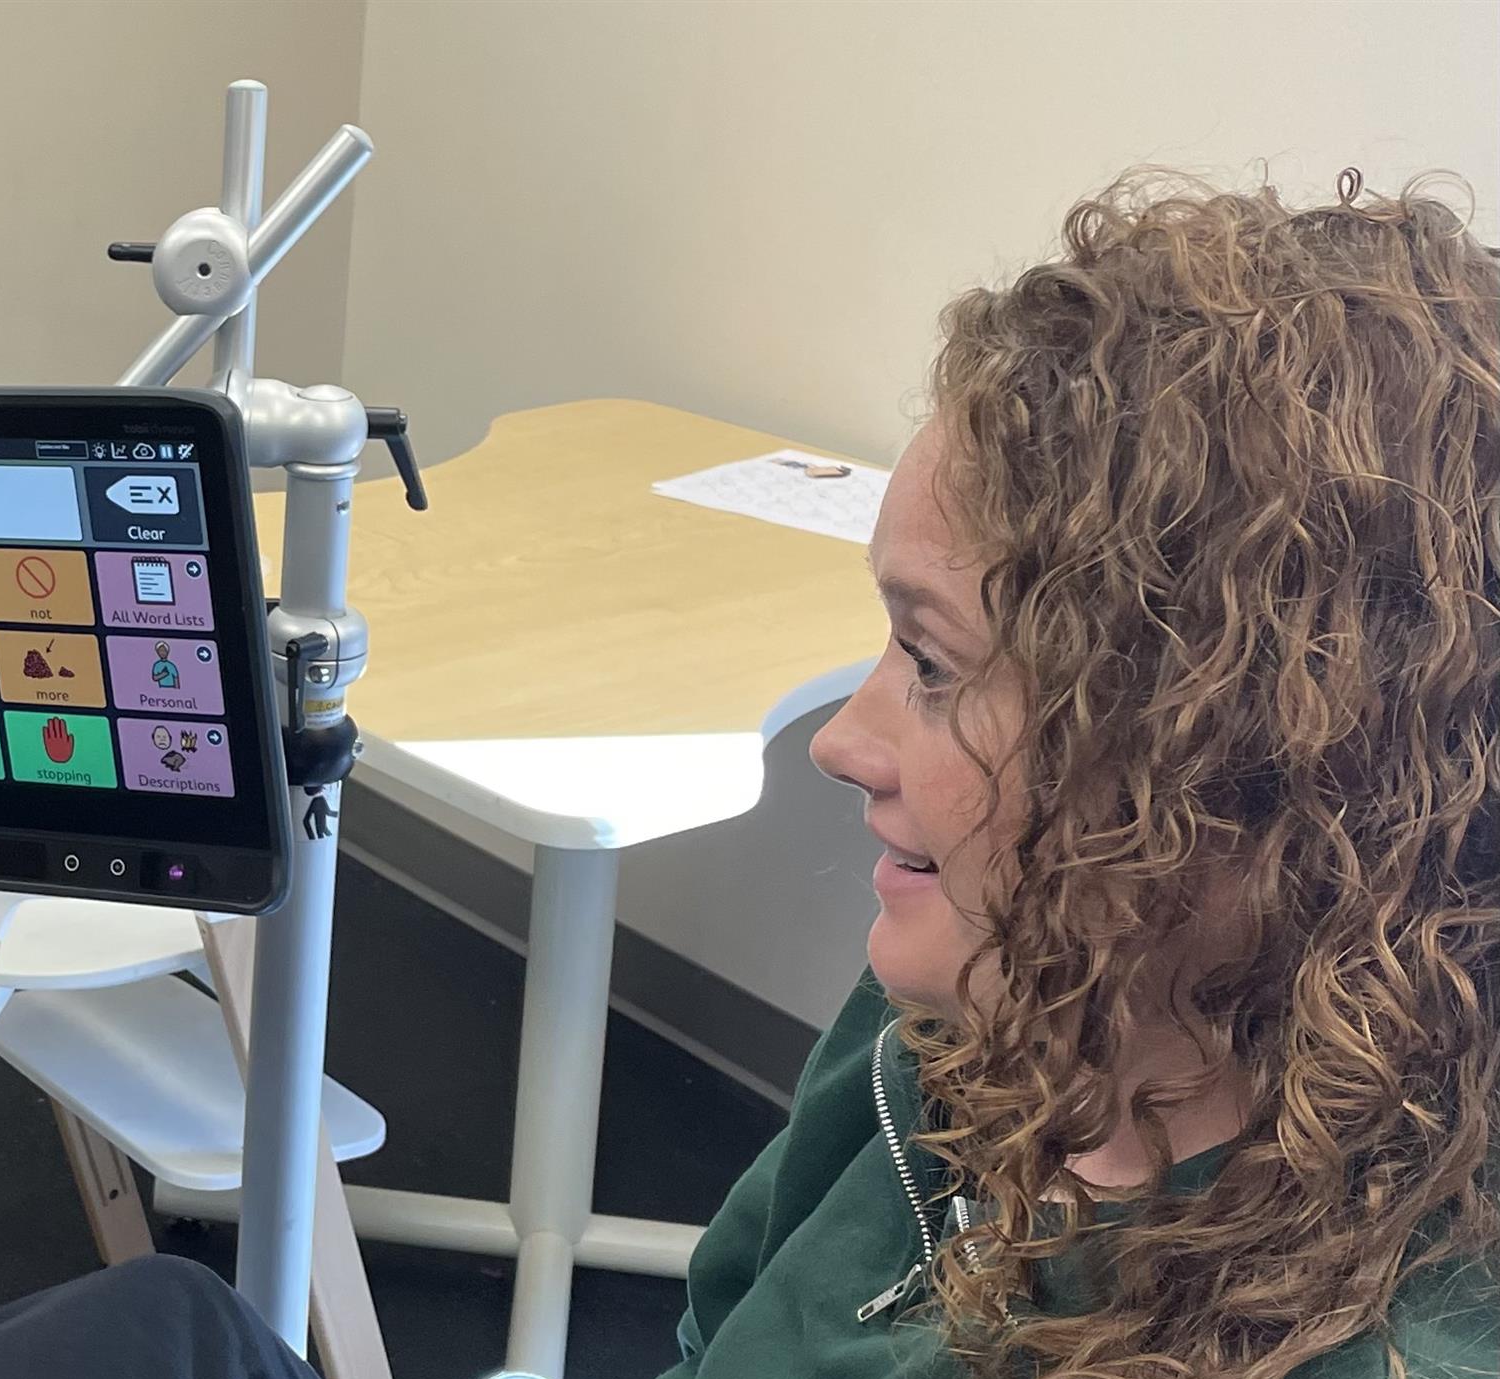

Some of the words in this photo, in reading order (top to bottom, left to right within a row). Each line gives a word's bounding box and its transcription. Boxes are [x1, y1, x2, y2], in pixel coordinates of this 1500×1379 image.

[127, 525, 166, 541] Clear
[30, 609, 52, 620] not
[111, 610, 131, 624] All
[133, 611, 171, 625] Word
[174, 613, 205, 627] Lists
[36, 690, 69, 702] more
[139, 693, 198, 710] Personal
[36, 768, 92, 785] stopping
[137, 774, 221, 793] Descriptions
